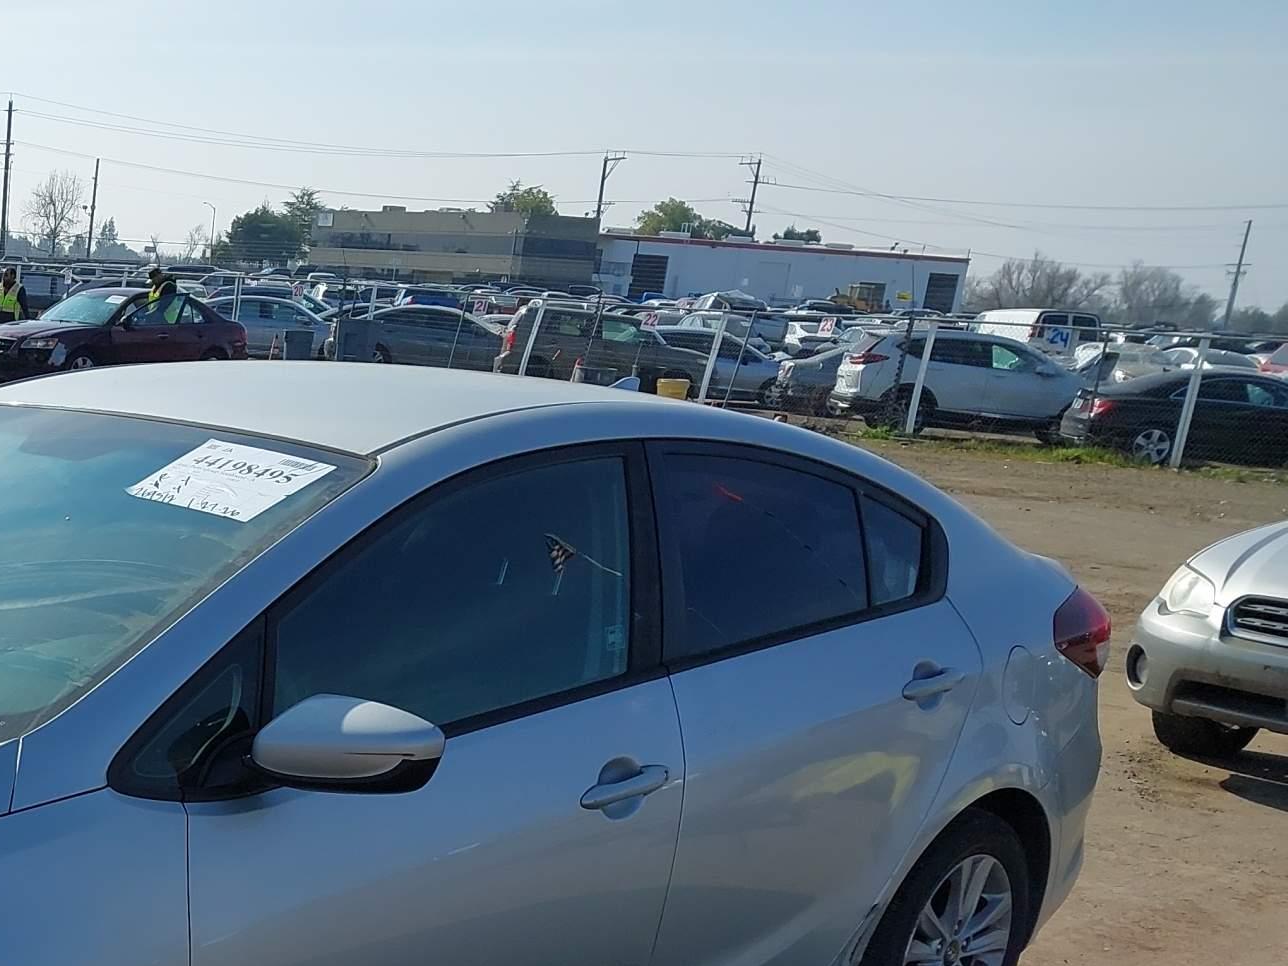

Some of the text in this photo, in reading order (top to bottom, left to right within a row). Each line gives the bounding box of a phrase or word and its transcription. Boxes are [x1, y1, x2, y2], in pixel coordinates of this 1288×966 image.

[294, 285, 304, 296] 20
[474, 301, 487, 312] 21
[643, 313, 658, 326] 22
[820, 319, 834, 332] 23
[1048, 328, 1069, 348] 24
[193, 455, 300, 484] 44198495
